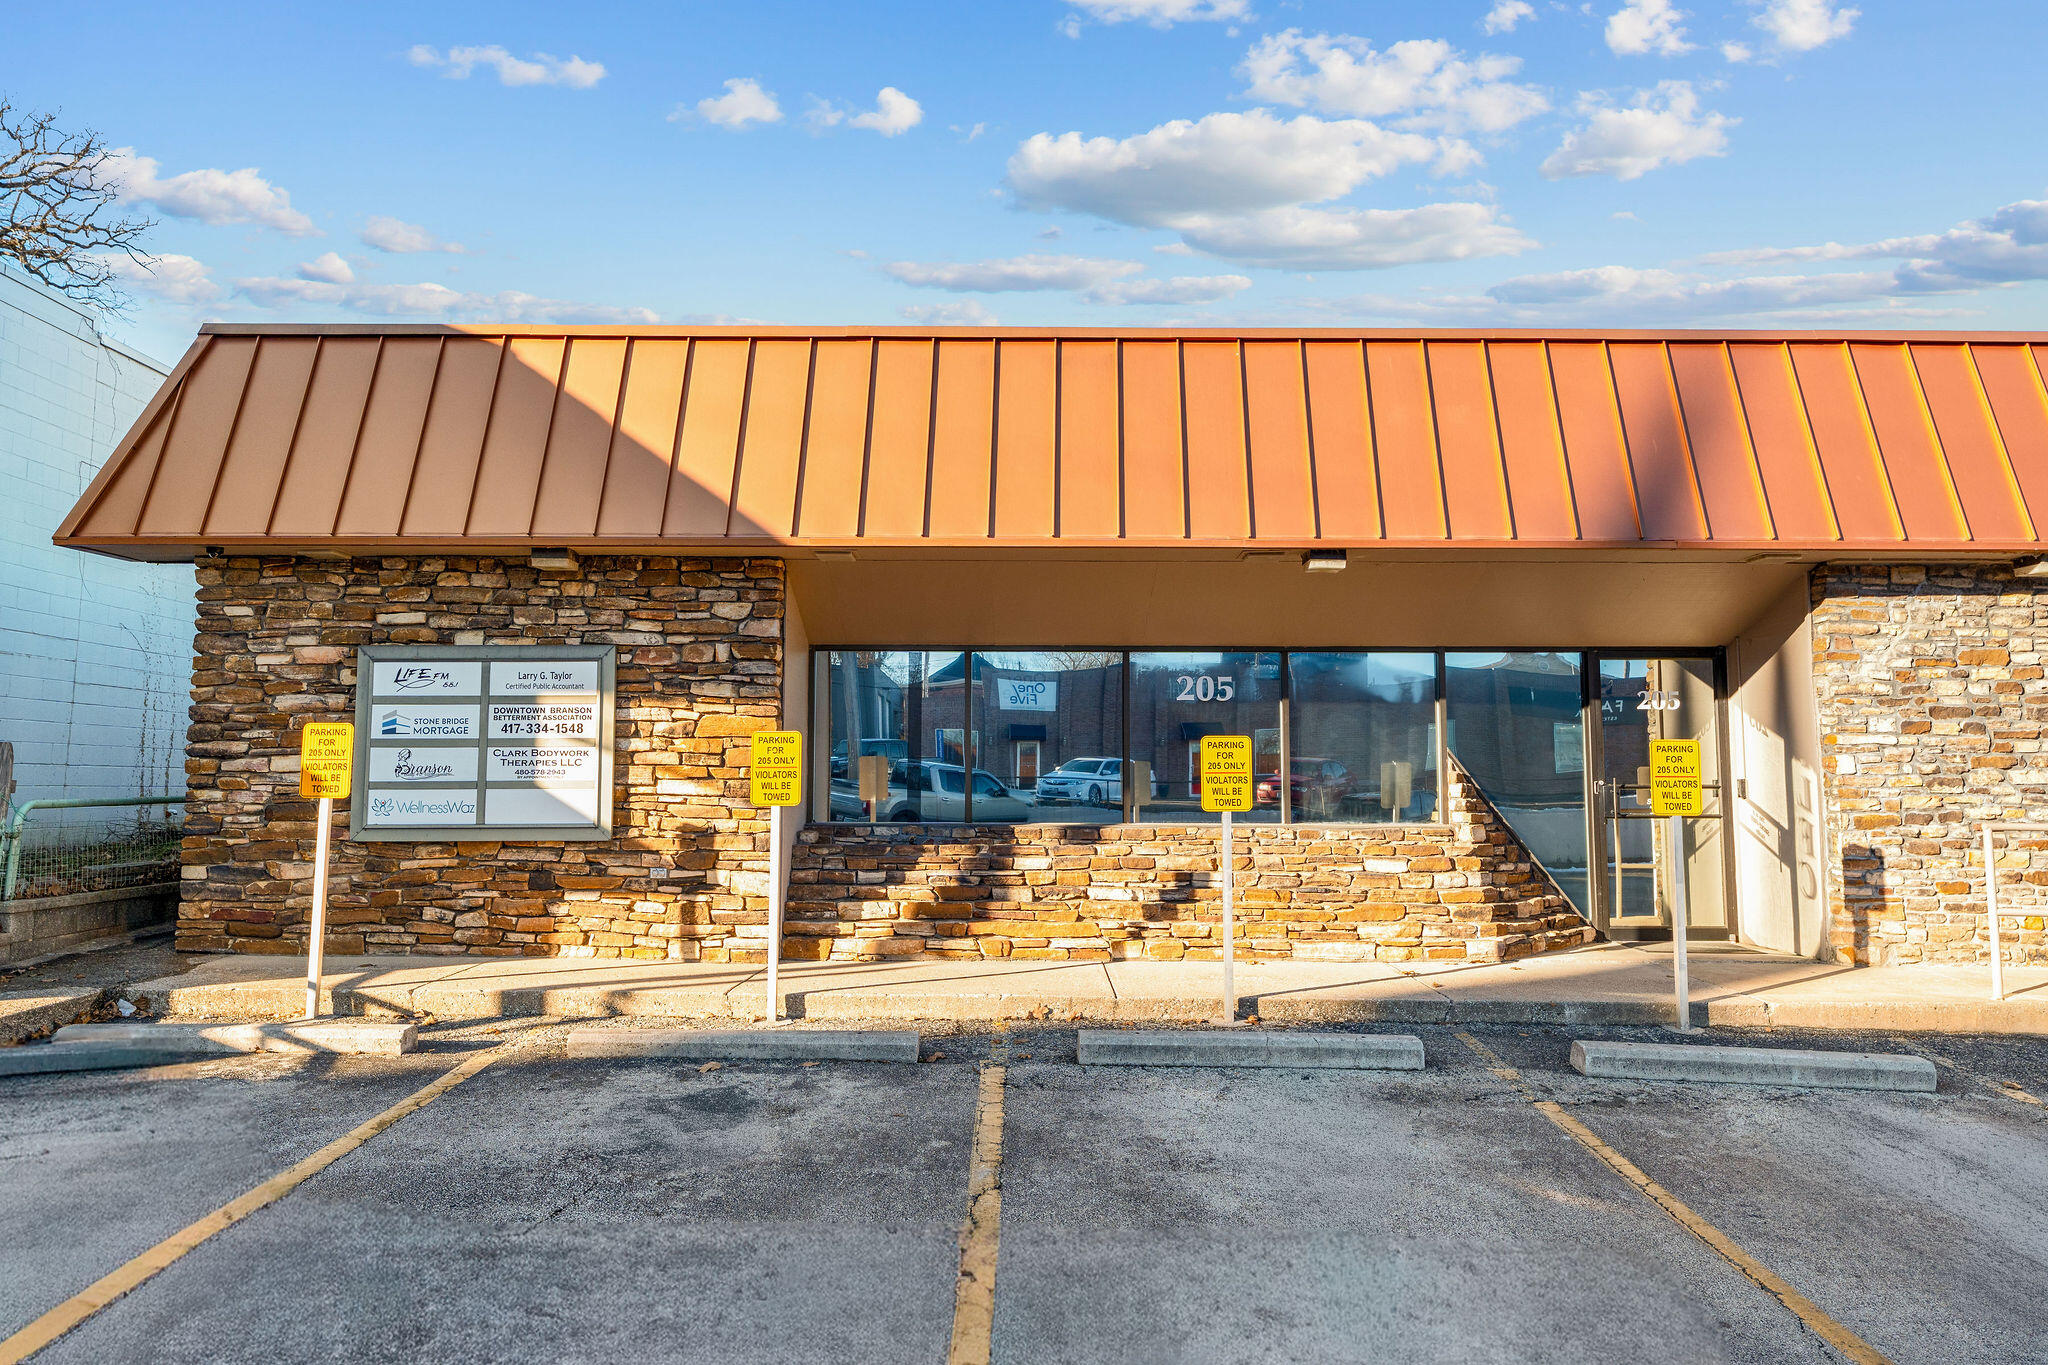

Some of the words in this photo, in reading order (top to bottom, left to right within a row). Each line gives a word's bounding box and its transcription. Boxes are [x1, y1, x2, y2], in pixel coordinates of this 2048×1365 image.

[394, 667, 432, 683] LIFE
[433, 672, 450, 680] FM
[518, 671, 538, 681] Larry
[540, 671, 548, 680] G.
[550, 671, 573, 681] Taylor
[1176, 675, 1233, 702] 205
[1636, 690, 1681, 711] 205
[414, 717, 440, 725] STONE
[441, 717, 469, 725] BRIDGE
[310, 728, 347, 736] PARKING
[413, 726, 469, 735] MORTGAGE
[501, 723, 584, 734] 417-334-1548
[318, 738, 336, 746] FOR
[758, 736, 795, 744] PARKING
[1207, 741, 1245, 749] PARKING
[1656, 745, 1694, 753] PARKING
[493, 749, 528, 757] CLARK
[531, 749, 590, 757] BODYWORK
[767, 746, 784, 754] FOR
[1216, 751, 1234, 759] FOR
[1665, 755, 1683, 763] FOR
[500, 758, 558, 767] THERAPIES
[560, 758, 583, 767] LLC
[1207, 762, 1222, 770] 205
[1223, 762, 1246, 770] ONLY
[305, 763, 348, 771] VIOLATORS
[394, 762, 453, 778] Branson
[1657, 766, 1671, 774] 205
[1673, 766, 1695, 774] ONLY
[310, 774, 329, 782] WILL
[331, 774, 341, 782] BE
[755, 770, 798, 779] VIOLATORS
[1205, 776, 1249, 784] VIOLATORS
[1655, 780, 1699, 788] VIOLATORS
[312, 785, 340, 793] TOWED
[761, 781, 779, 790] WILL
[781, 781, 792, 790] BE
[1211, 787, 1230, 796] WILL
[1232, 787, 1243, 796] BE
[1661, 791, 1680, 800] WILL
[1682, 791, 1693, 800] BE
[763, 793, 791, 801] TOWED
[1214, 798, 1242, 807] TOWED
[1664, 802, 1692, 811] TOWED
[396, 800, 476, 814] WellnessWaz
